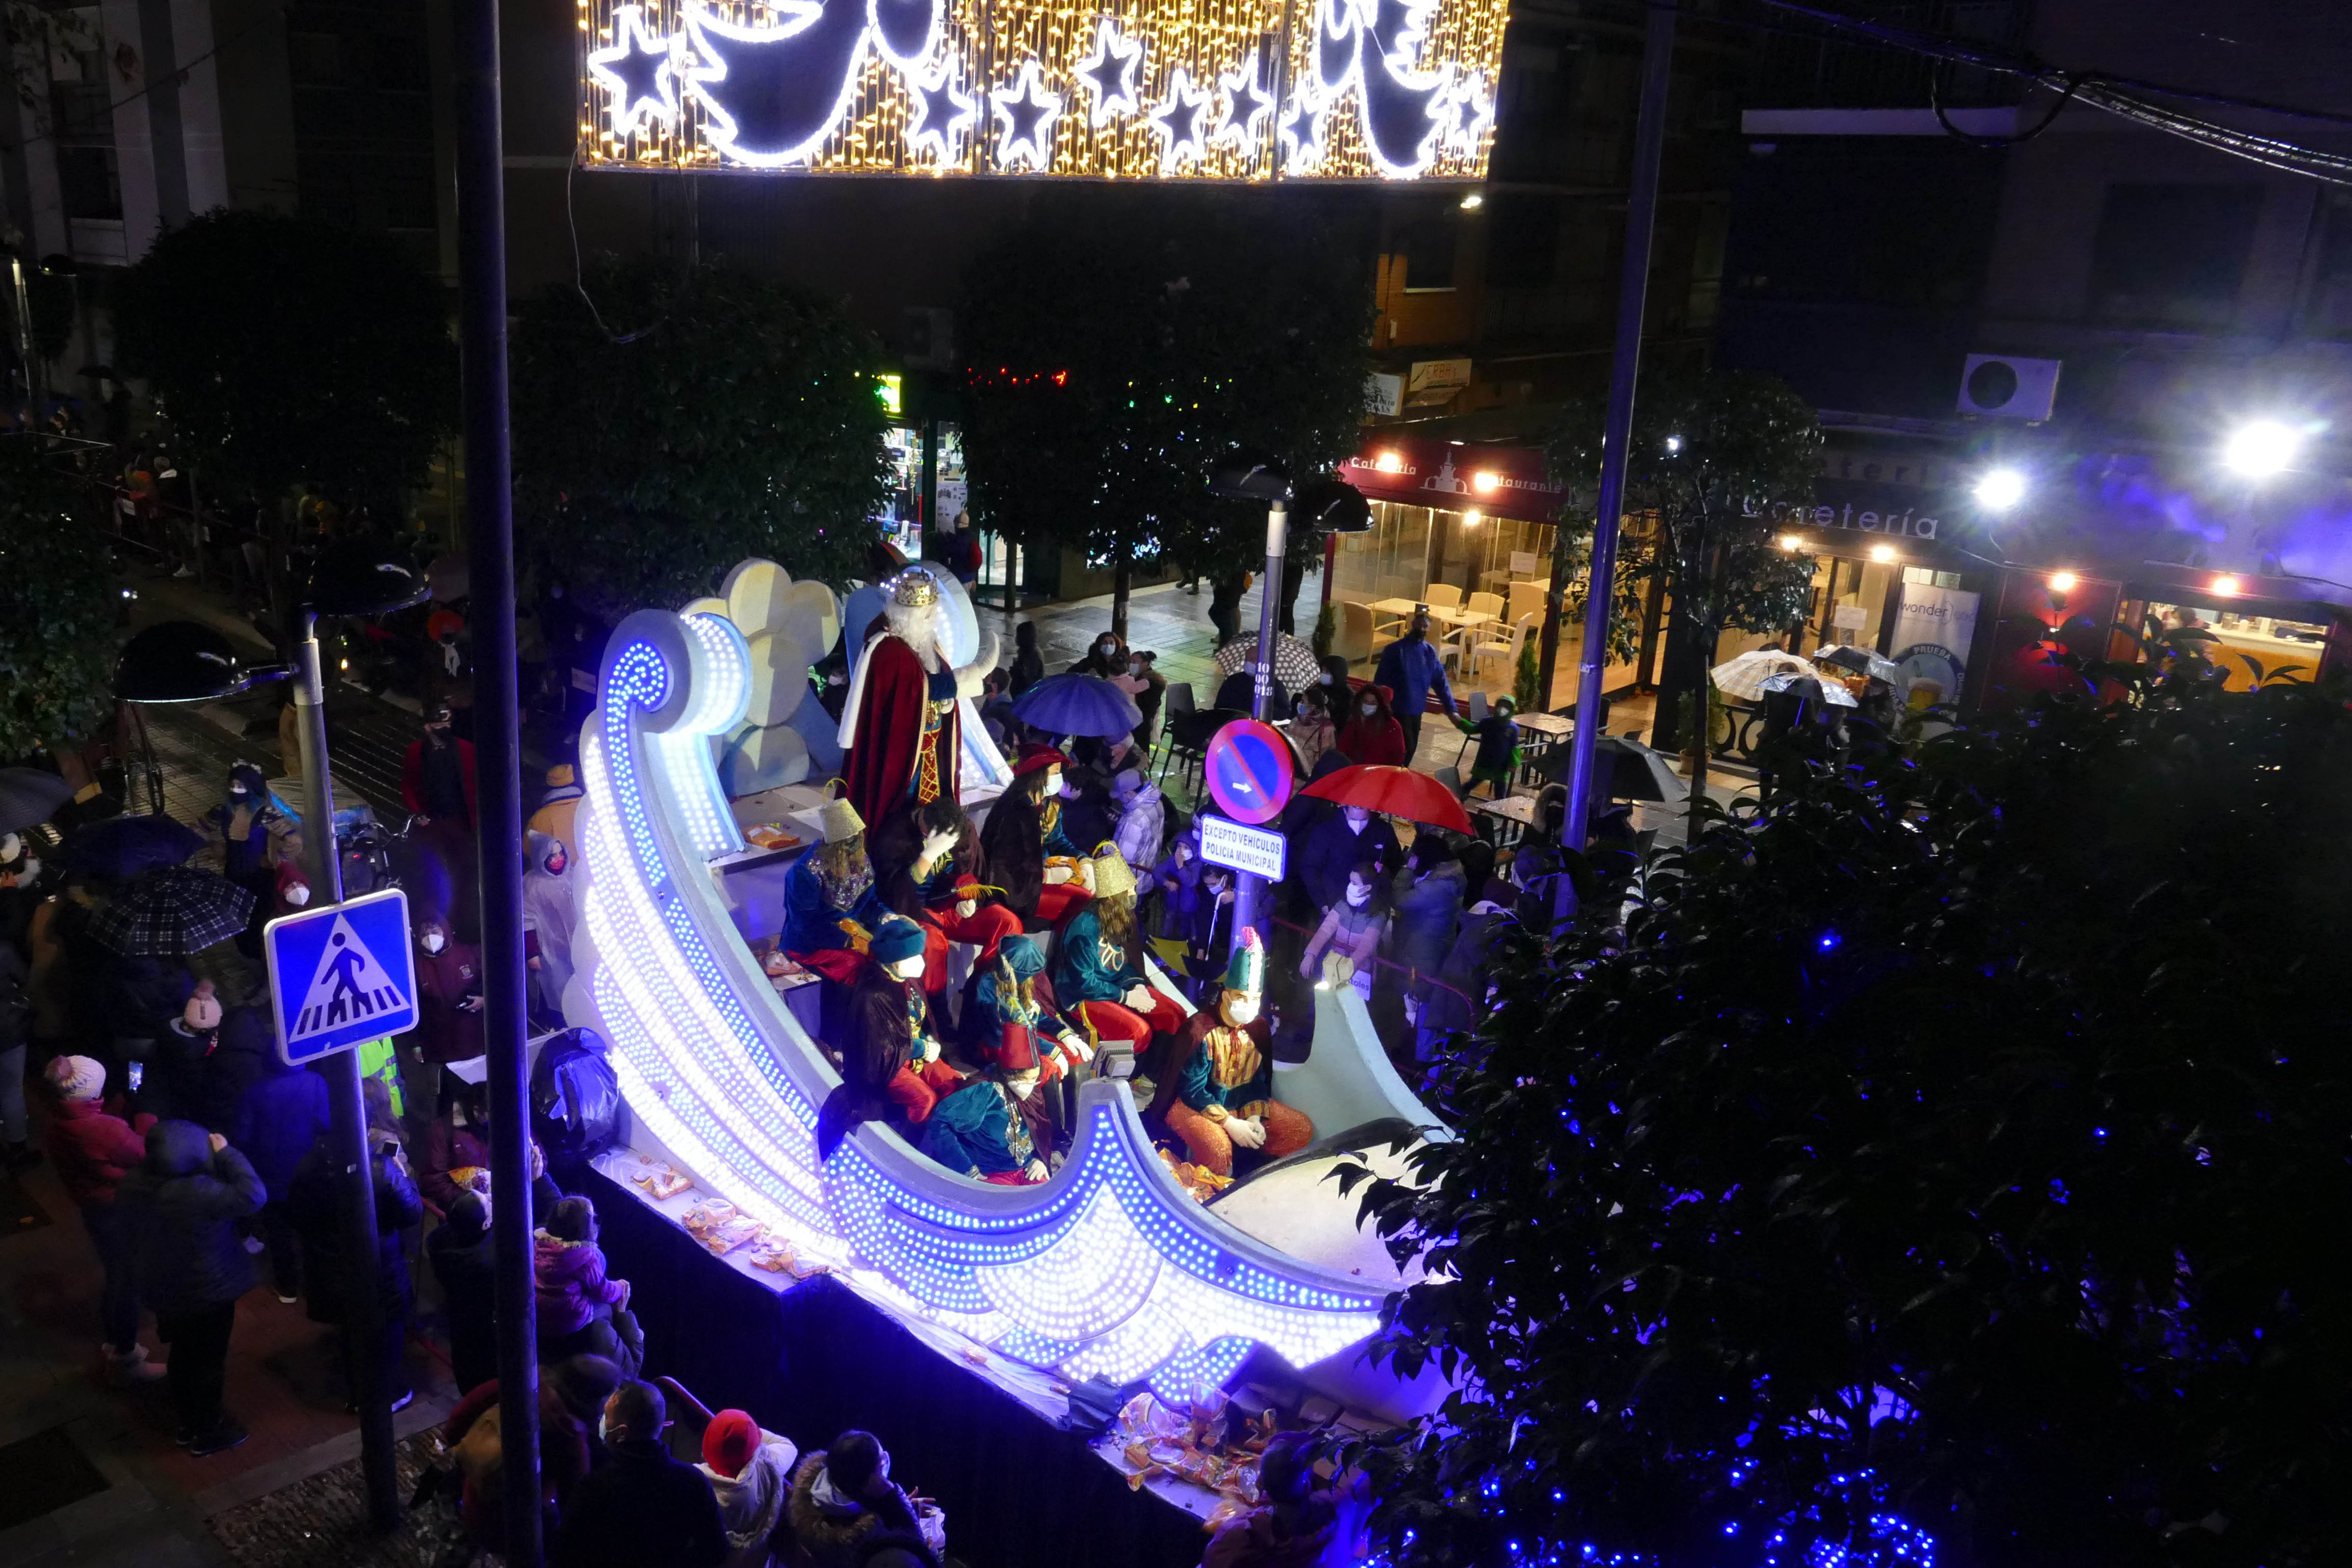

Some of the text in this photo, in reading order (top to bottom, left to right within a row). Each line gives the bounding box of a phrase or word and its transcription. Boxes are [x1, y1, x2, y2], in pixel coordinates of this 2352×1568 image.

[1351, 457, 1416, 474] Cafería
[1476, 473, 1562, 493] taurante
[1900, 603, 1948, 617] wonder
[1914, 645, 1951, 661] PRUEBA
[1205, 824, 1237, 843] EXCEPTO
[1206, 842, 1276, 872] POLICIA MUNICIPAL
[1349, 979, 1370, 991] toles
